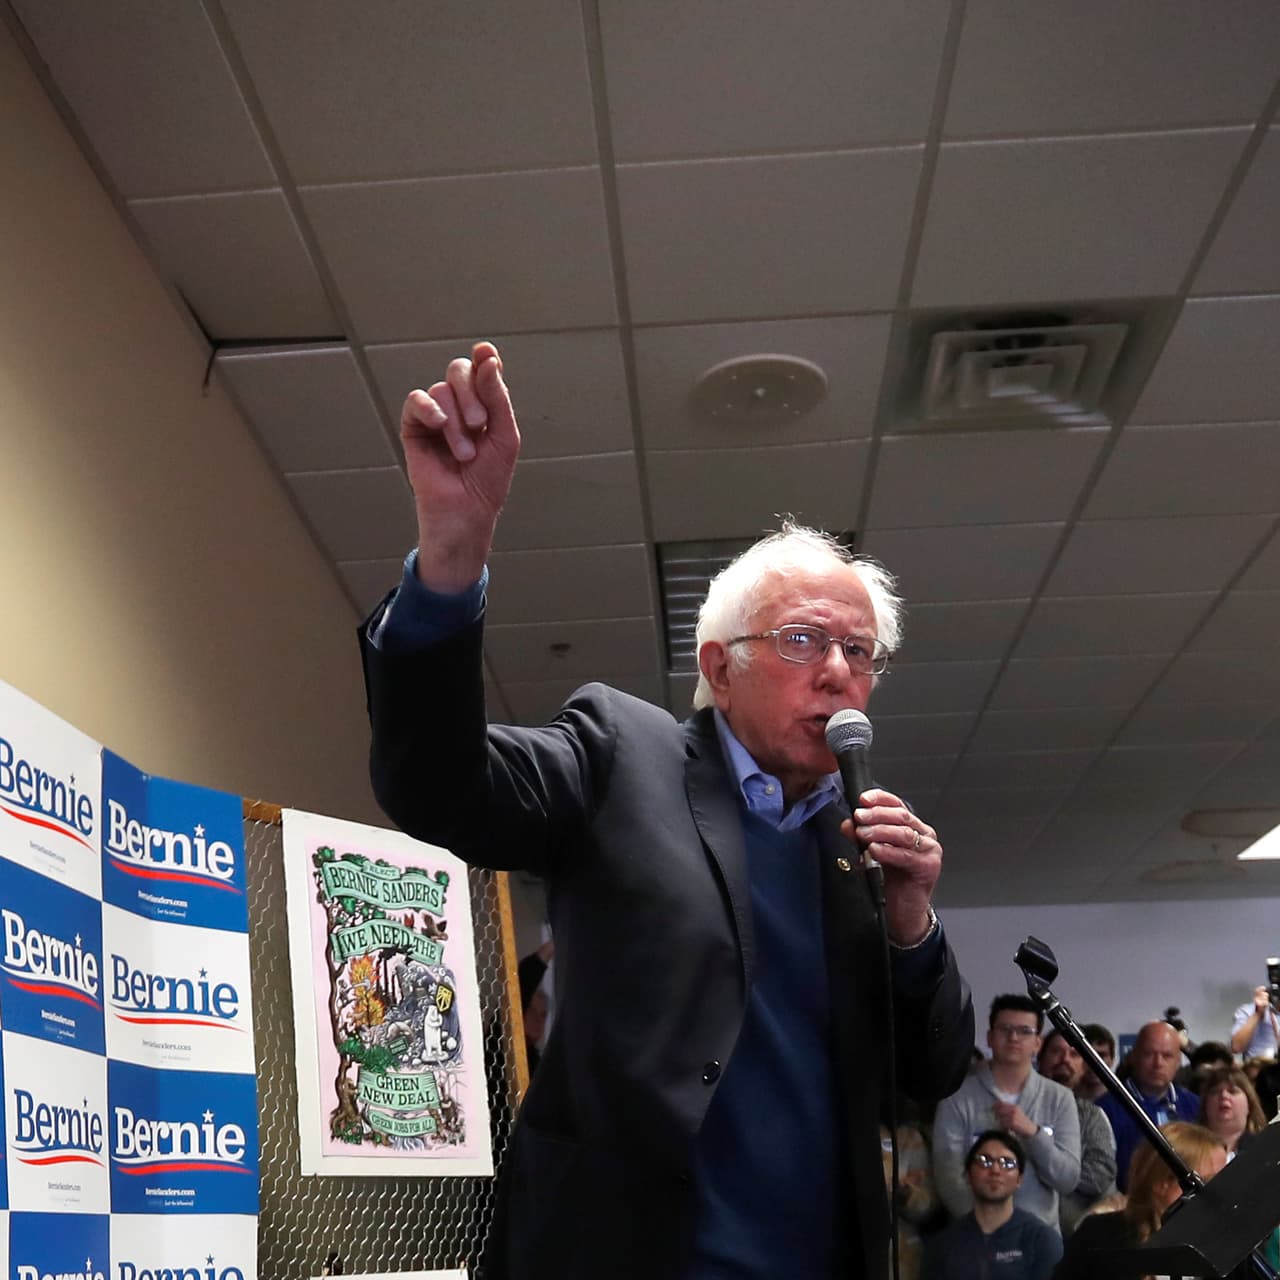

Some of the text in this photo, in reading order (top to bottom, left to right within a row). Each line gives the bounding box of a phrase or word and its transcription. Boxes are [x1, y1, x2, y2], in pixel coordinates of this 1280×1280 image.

[108, 799, 234, 879] Bernie
[329, 867, 439, 907] BERNIE SANDERS
[2, 909, 98, 996] Bernie
[341, 924, 437, 960] WE NEED THE
[111, 954, 238, 1019] Bernie
[363, 1085, 434, 1105] NEW DEAL
[376, 1074, 420, 1091] GREEN
[14, 1088, 102, 1150] Bernie
[115, 1107, 245, 1161] Bernie
